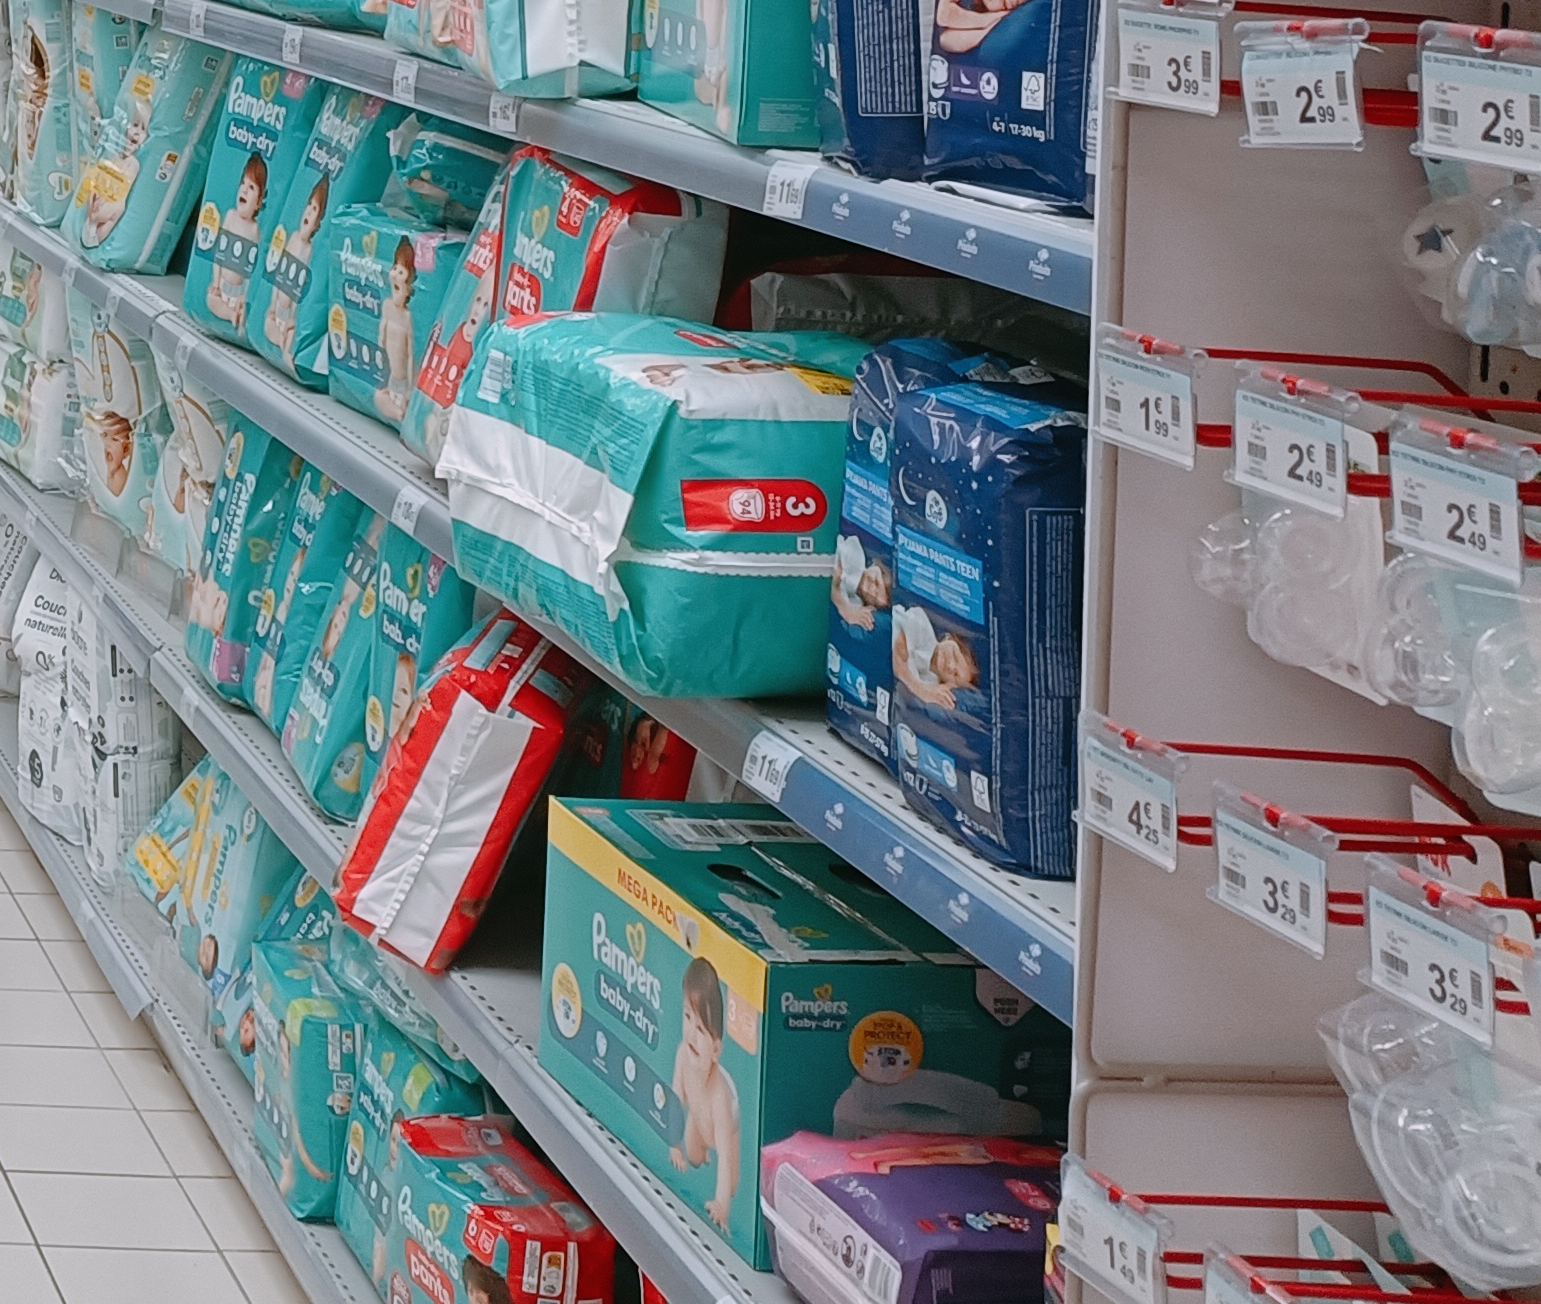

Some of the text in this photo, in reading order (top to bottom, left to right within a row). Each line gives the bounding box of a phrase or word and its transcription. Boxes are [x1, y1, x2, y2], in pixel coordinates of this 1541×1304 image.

[1167, 55, 1199, 95] 3€99
[227, 76, 287, 132] Pampers
[320, 95, 360, 152] Pampers
[228, 122, 275, 158] baby-dry
[308, 142, 345, 178] baby-dry
[1140, 397, 1168, 437] 1€99
[1287, 443, 1322, 488] 2€49
[785, 495, 816, 518] 3
[1447, 502, 1487, 551] 2€49
[929, 547, 955, 569] PANTS
[956, 560, 980, 582] TEEN
[1128, 800, 1159, 845] 4€25
[617, 867, 649, 904] MEGA
[1262, 876, 1297, 925] 3€29
[592, 912, 662, 1011] Pampers
[600, 973, 658, 1045] baby-dry
[781, 991, 849, 1017] Pampers
[1428, 962, 1468, 1016] 3€29
[788, 1017, 844, 1030] baby-dry
[398, 1185, 461, 1282] Pampers
